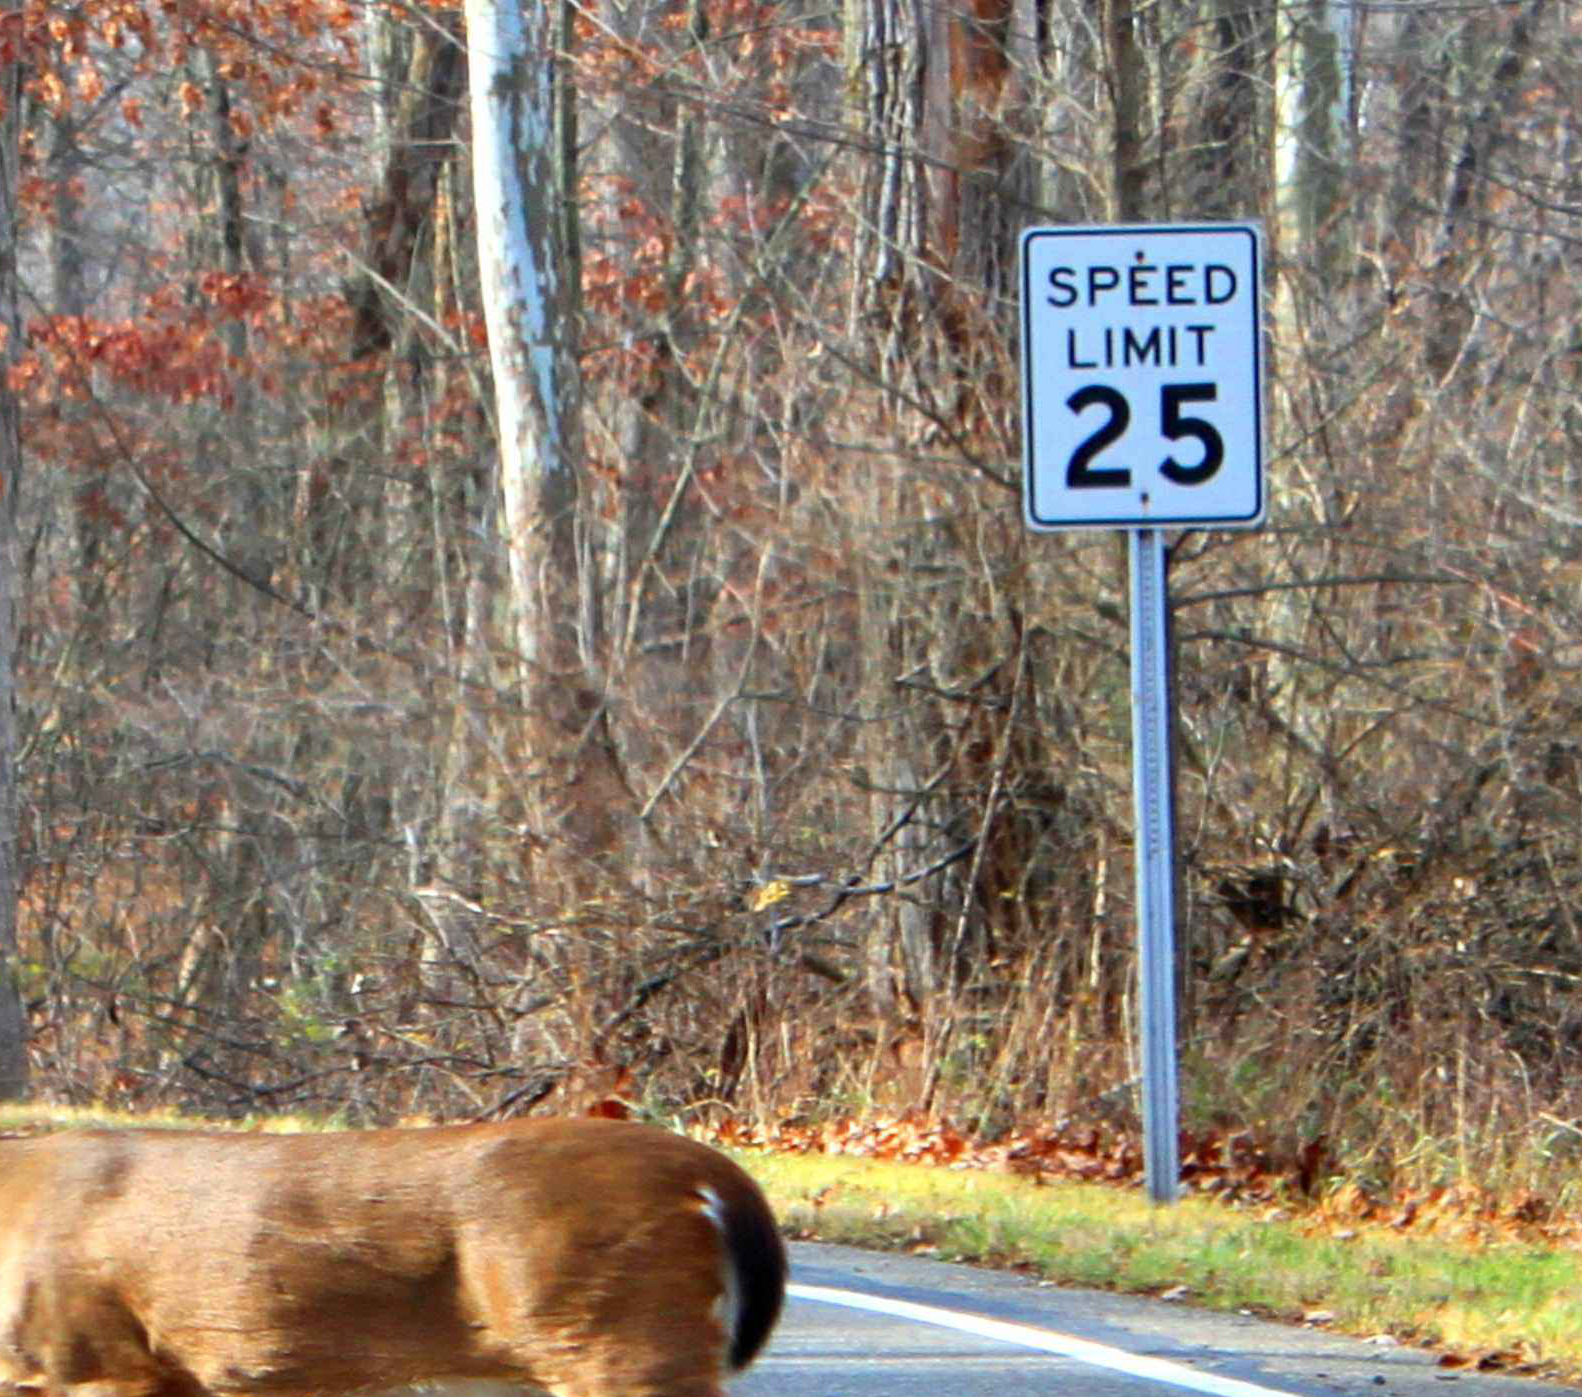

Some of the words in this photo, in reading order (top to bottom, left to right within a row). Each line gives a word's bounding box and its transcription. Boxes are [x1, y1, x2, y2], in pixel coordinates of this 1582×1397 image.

[1046, 264, 1238, 308] SPEED
[1067, 325, 1216, 369] LIMIT
[1064, 382, 1225, 489] 25
